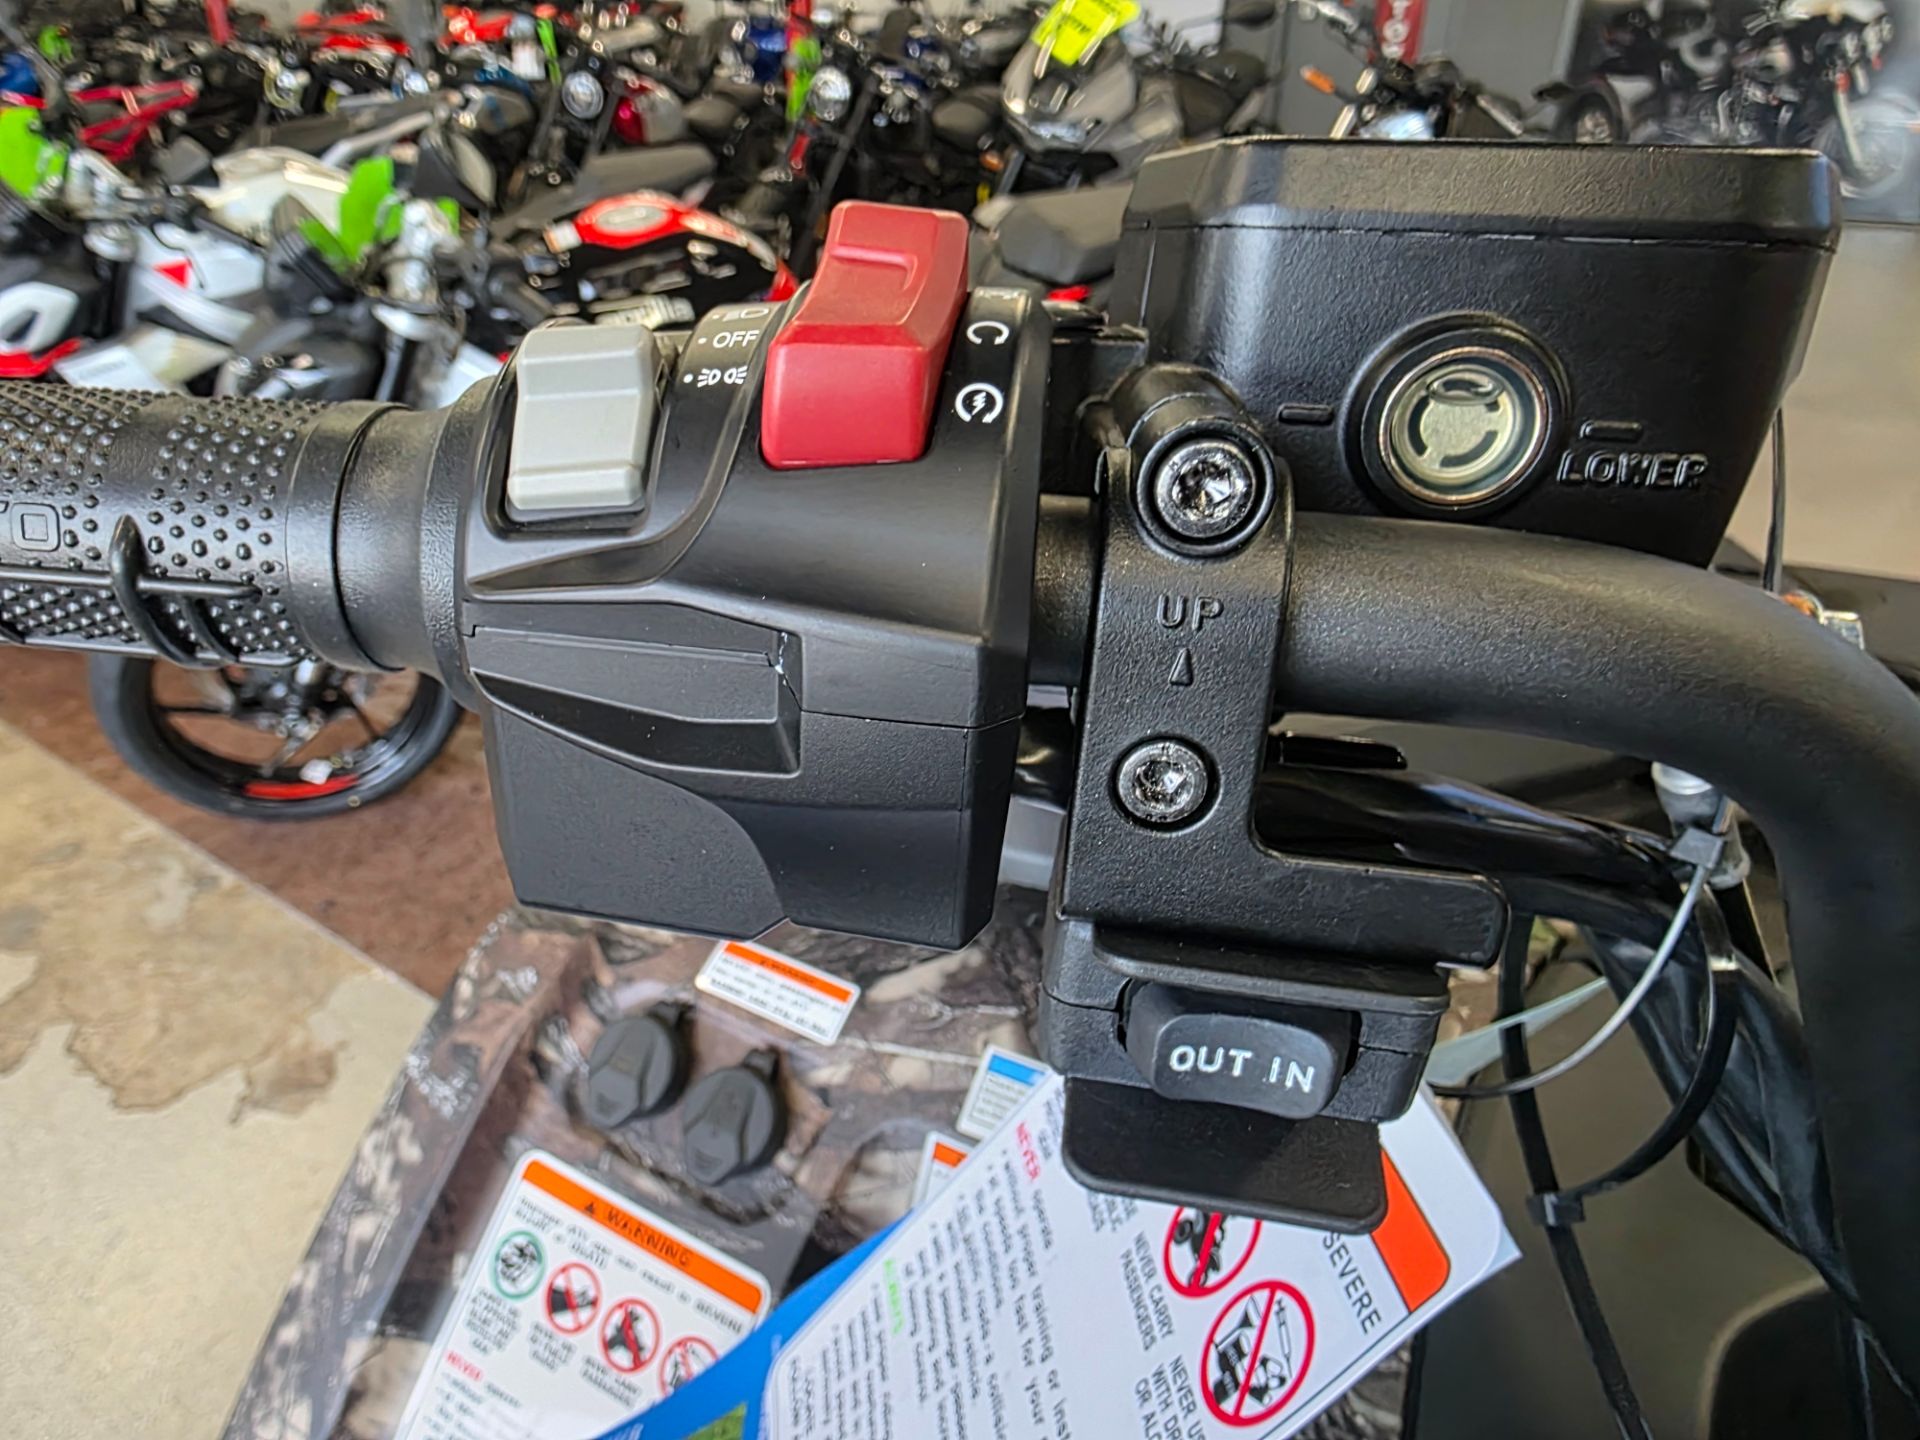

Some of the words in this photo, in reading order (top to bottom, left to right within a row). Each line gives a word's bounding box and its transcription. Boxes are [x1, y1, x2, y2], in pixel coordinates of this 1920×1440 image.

[712, 330, 760, 349] OFF
[1556, 449, 1709, 488] LOWER
[1156, 593, 1224, 632] UP
[1169, 1044, 1253, 1077] OUT
[1268, 1056, 1315, 1094] IN
[607, 1209, 692, 1268] WARNING
[1119, 1248, 1158, 1352] PASSENGERS
[1322, 1230, 1382, 1336] SEVERE
[1014, 1293, 1029, 1334] fast
[1154, 1283, 1175, 1340] CARRY
[1022, 1335, 1036, 1369] for
[1031, 1283, 1056, 1365] training
[1047, 1367, 1061, 1392] or
[1024, 1375, 1045, 1426] your
[1134, 1376, 1153, 1409] OR
[1151, 1362, 1175, 1413] WITH
[1168, 1354, 1198, 1420] NEVER
